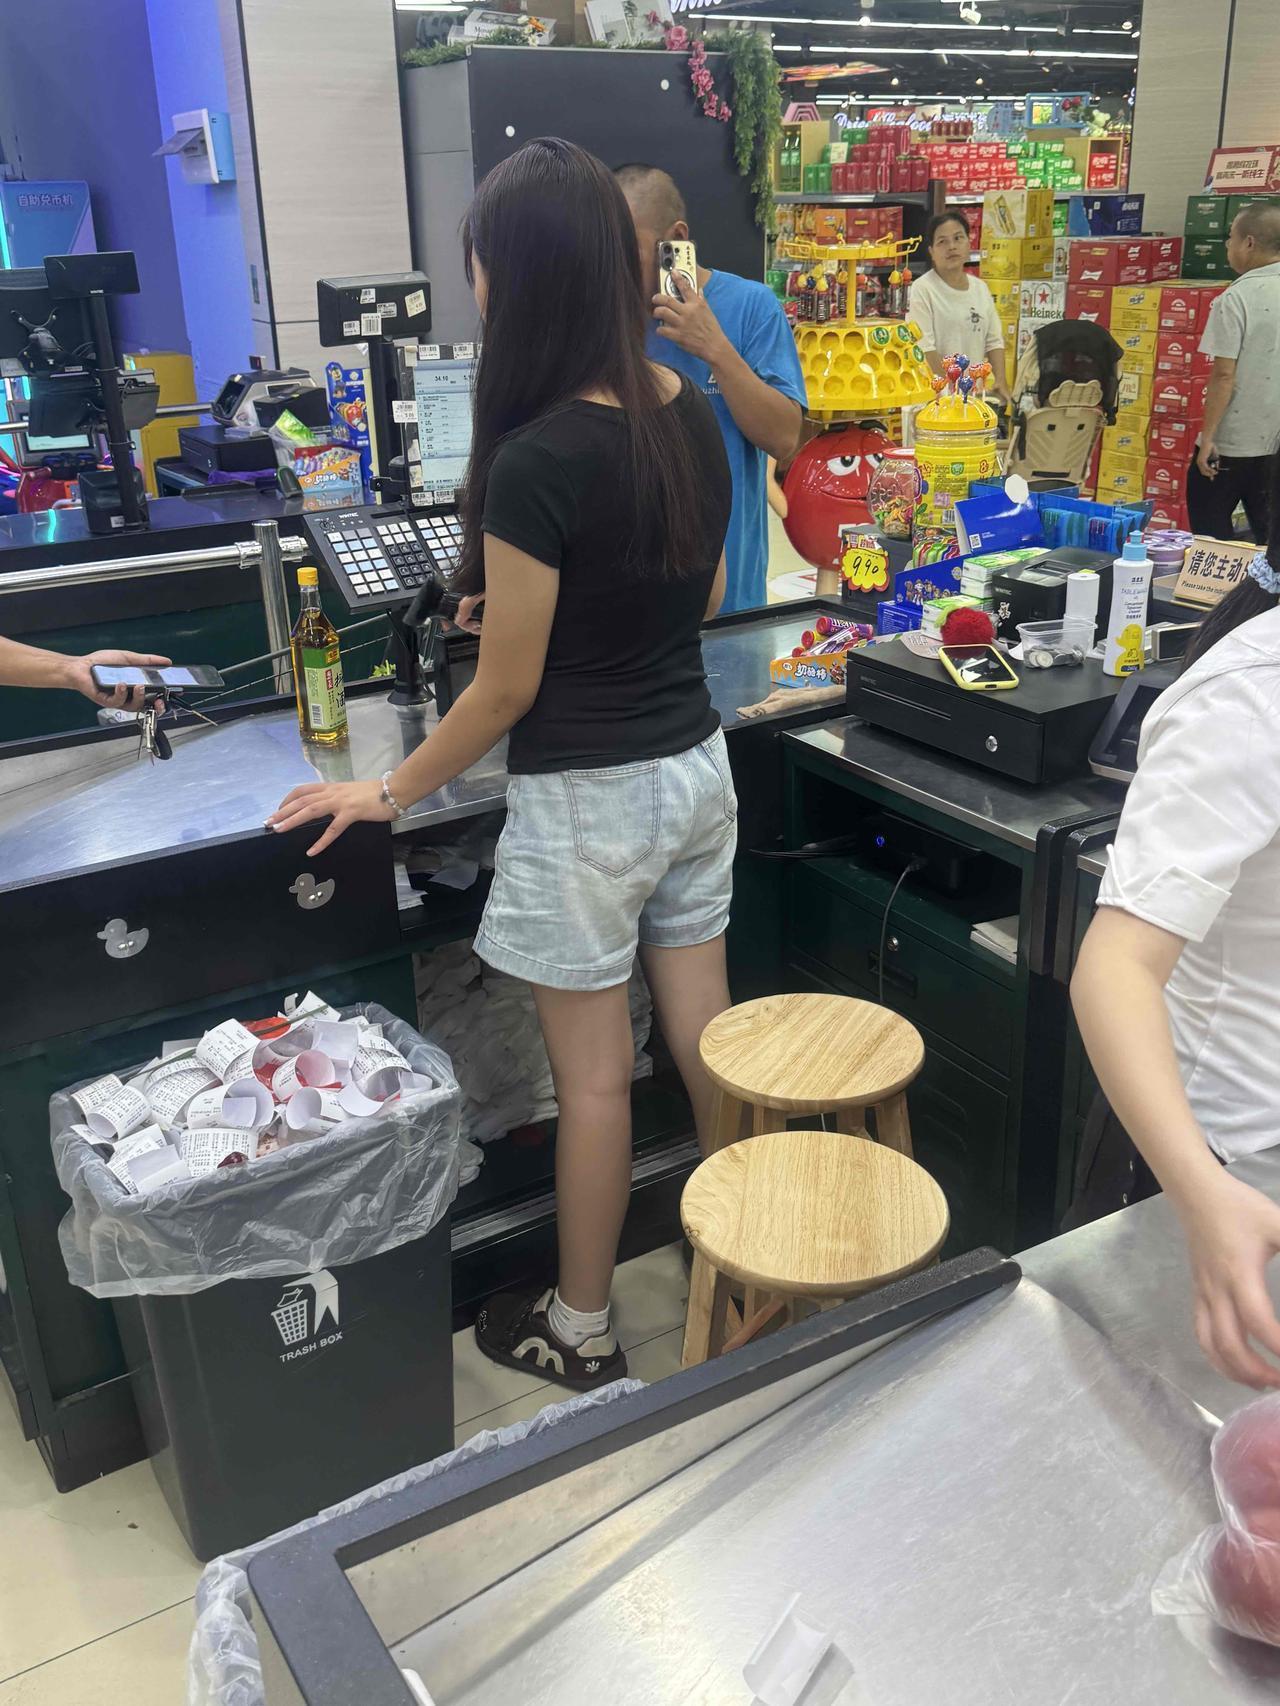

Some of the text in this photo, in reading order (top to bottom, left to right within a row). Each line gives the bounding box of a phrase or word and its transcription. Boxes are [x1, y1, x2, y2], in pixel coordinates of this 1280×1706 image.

[18, 193, 74, 207] 自助兑币机
[795, 662, 828, 680] 奶酪棒
[279, 1331, 343, 1363] TRASH BOX
